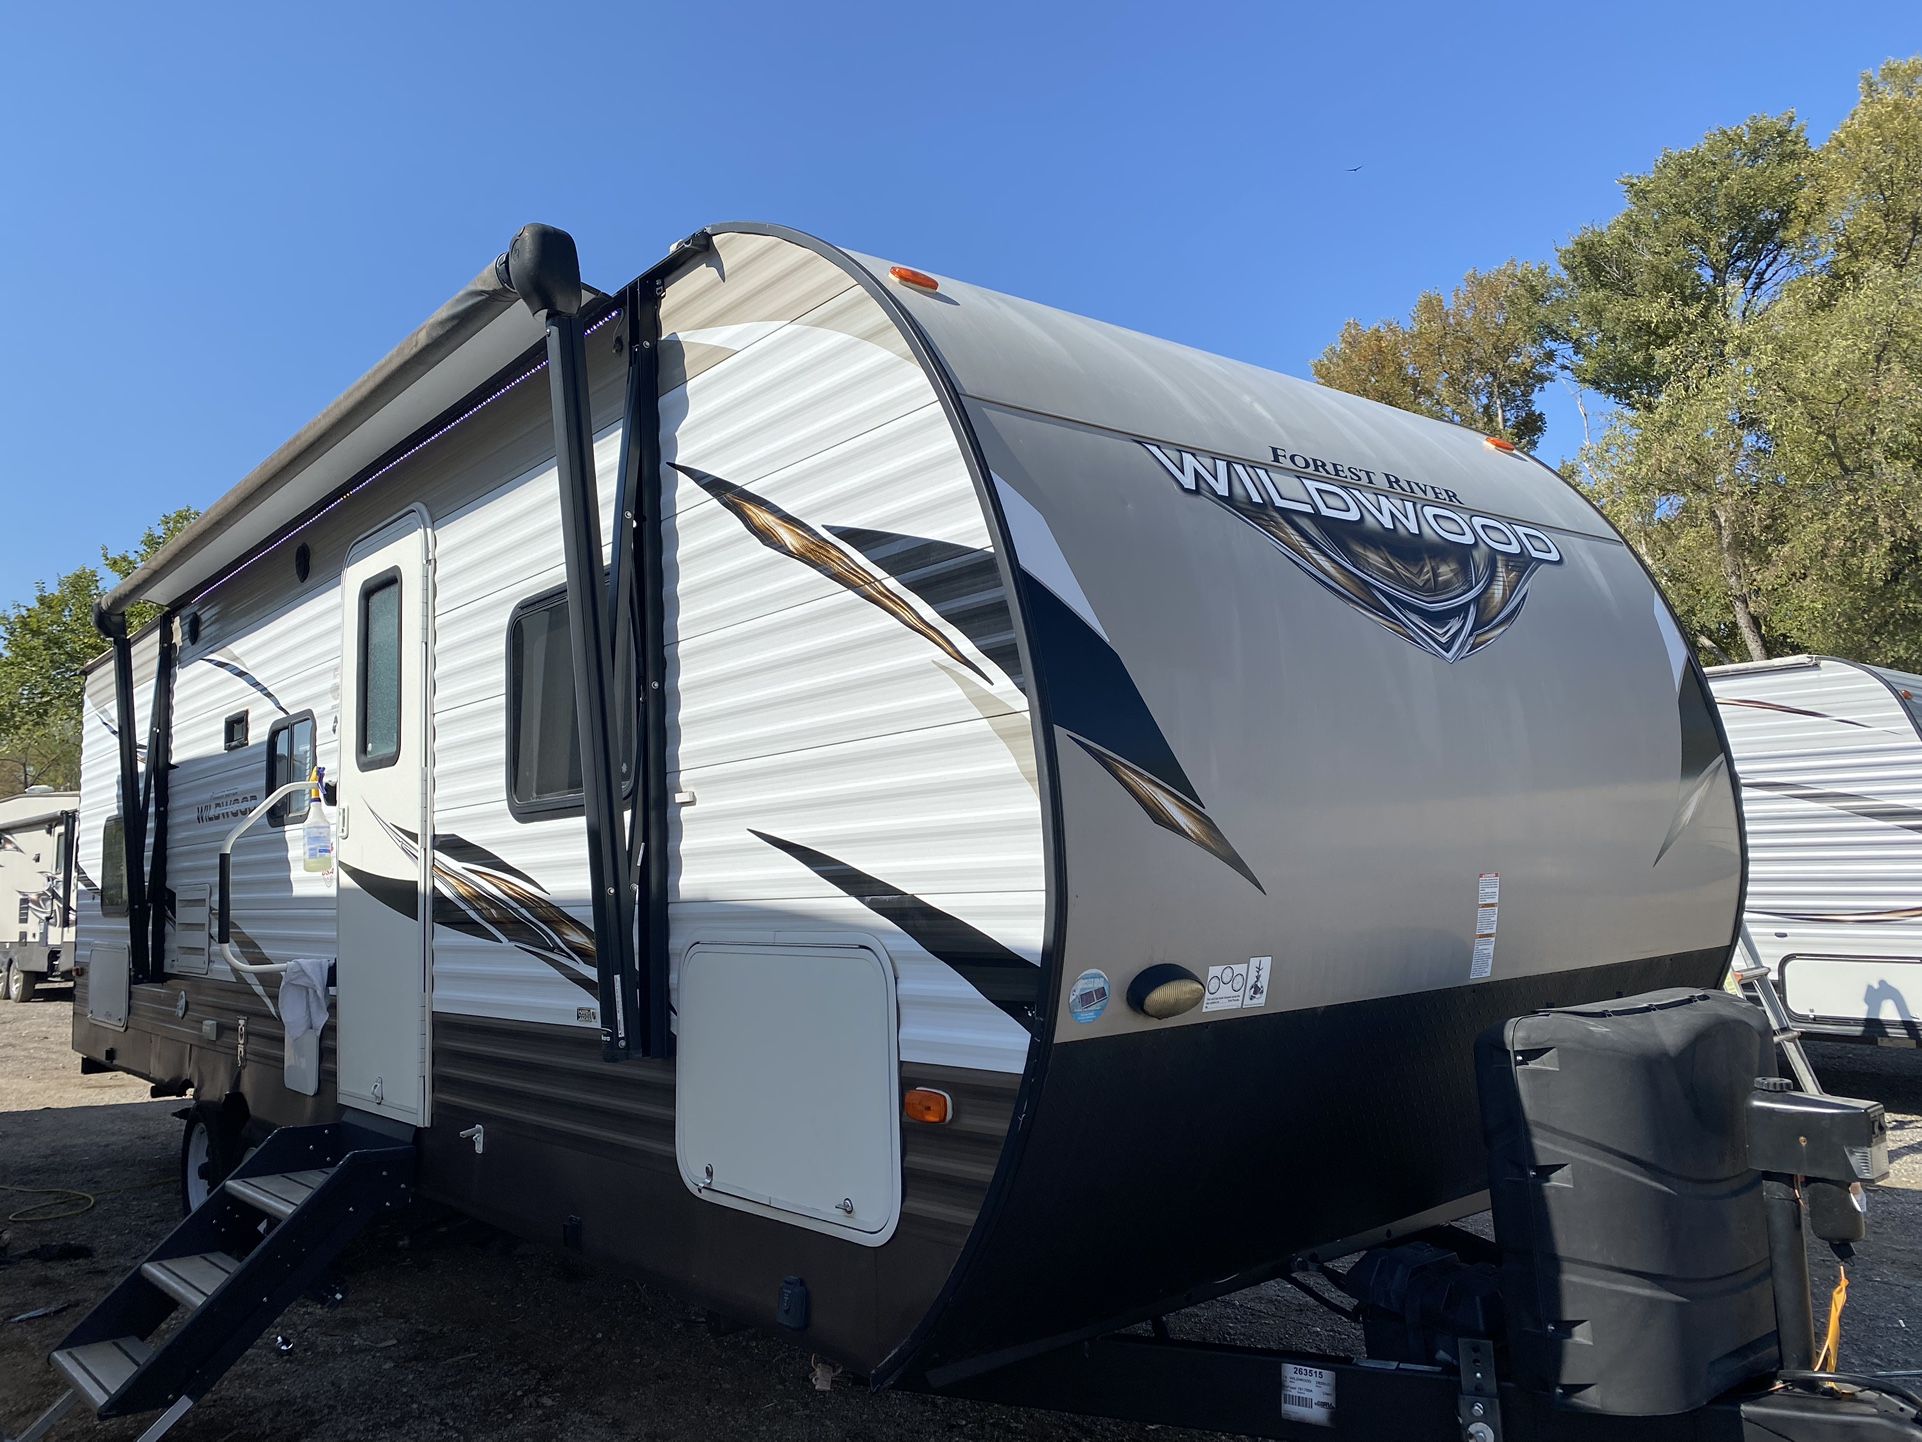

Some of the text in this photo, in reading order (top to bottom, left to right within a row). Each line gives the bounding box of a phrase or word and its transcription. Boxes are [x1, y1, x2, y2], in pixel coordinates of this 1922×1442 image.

[1136, 440, 1564, 563] WILDWOOD
[1269, 445, 1464, 505] FOREST RIVER
[1293, 1366, 1324, 1379] 263515
